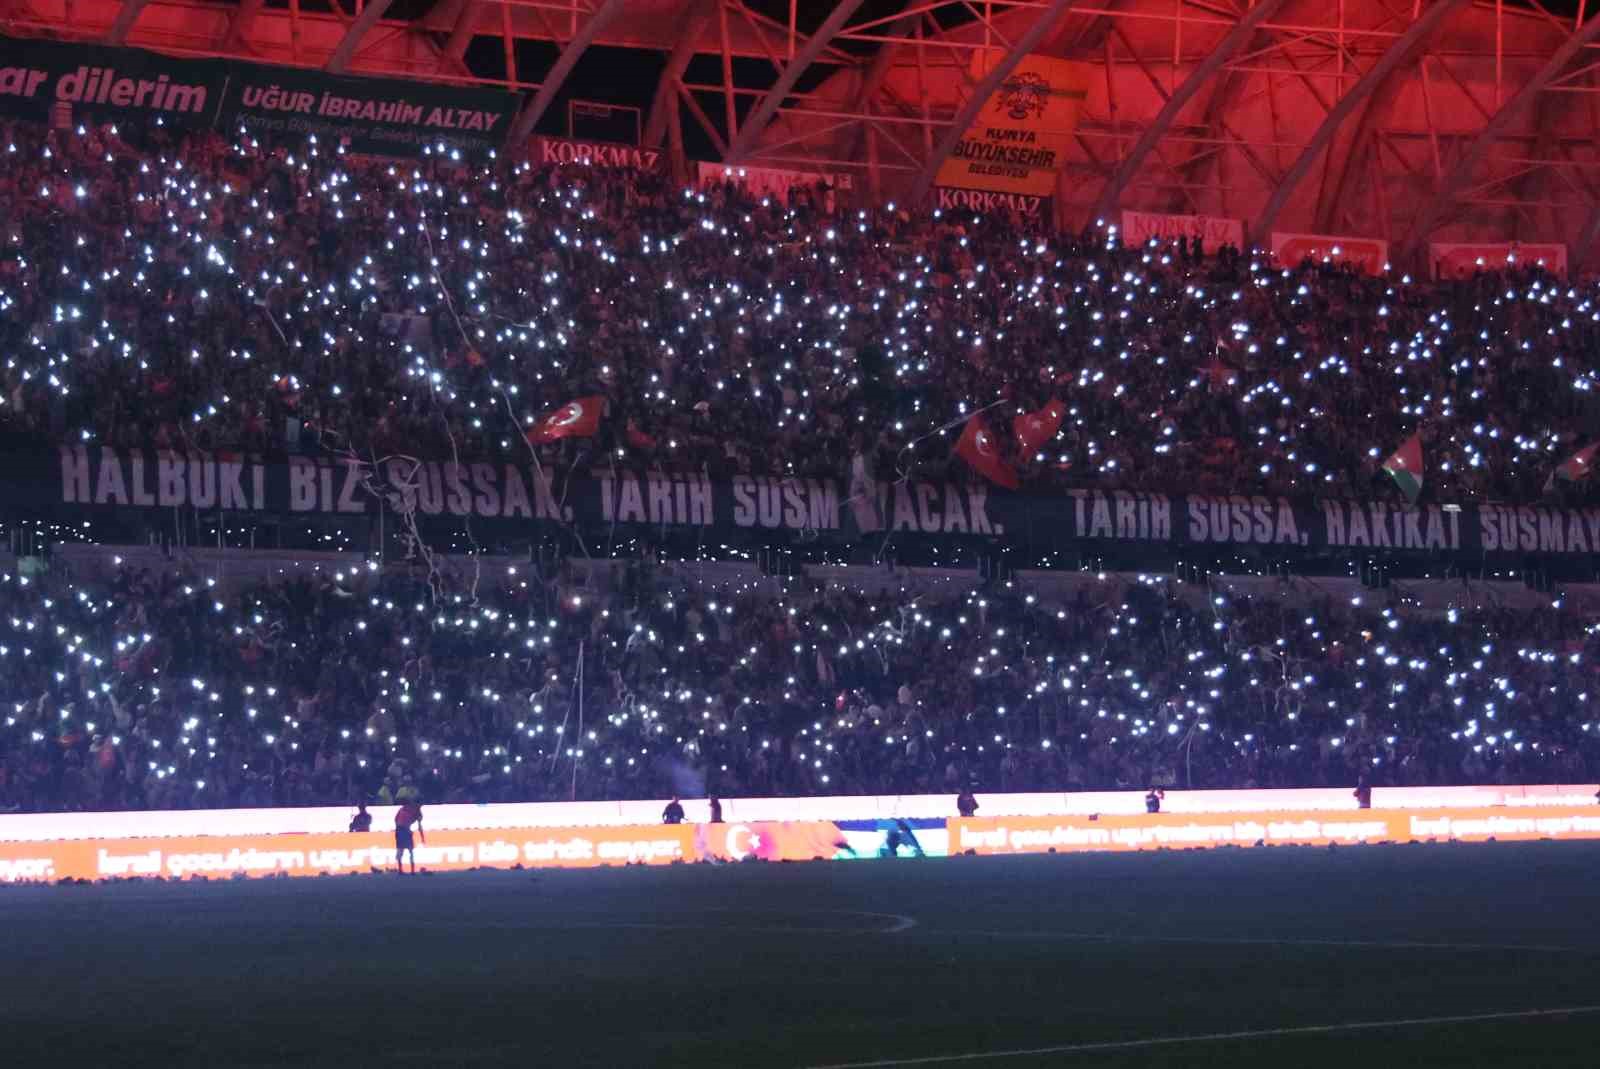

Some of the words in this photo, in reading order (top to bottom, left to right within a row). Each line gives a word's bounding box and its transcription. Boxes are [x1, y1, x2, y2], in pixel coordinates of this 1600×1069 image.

[55, 66, 208, 113] dilerim
[242, 84, 315, 113] UĞUR
[318, 91, 423, 124] İBRAHİM
[425, 106, 500, 131] ALTAY
[60, 445, 265, 511] HALBUKİ
[289, 455, 366, 513] BİZ
[386, 459, 573, 522] SUSSAK.
[591, 466, 714, 525] TARİH
[1067, 488, 1171, 538] TARİH
[1186, 495, 1310, 546] SUSSA,
[1322, 499, 1462, 549] HAKİKAT
